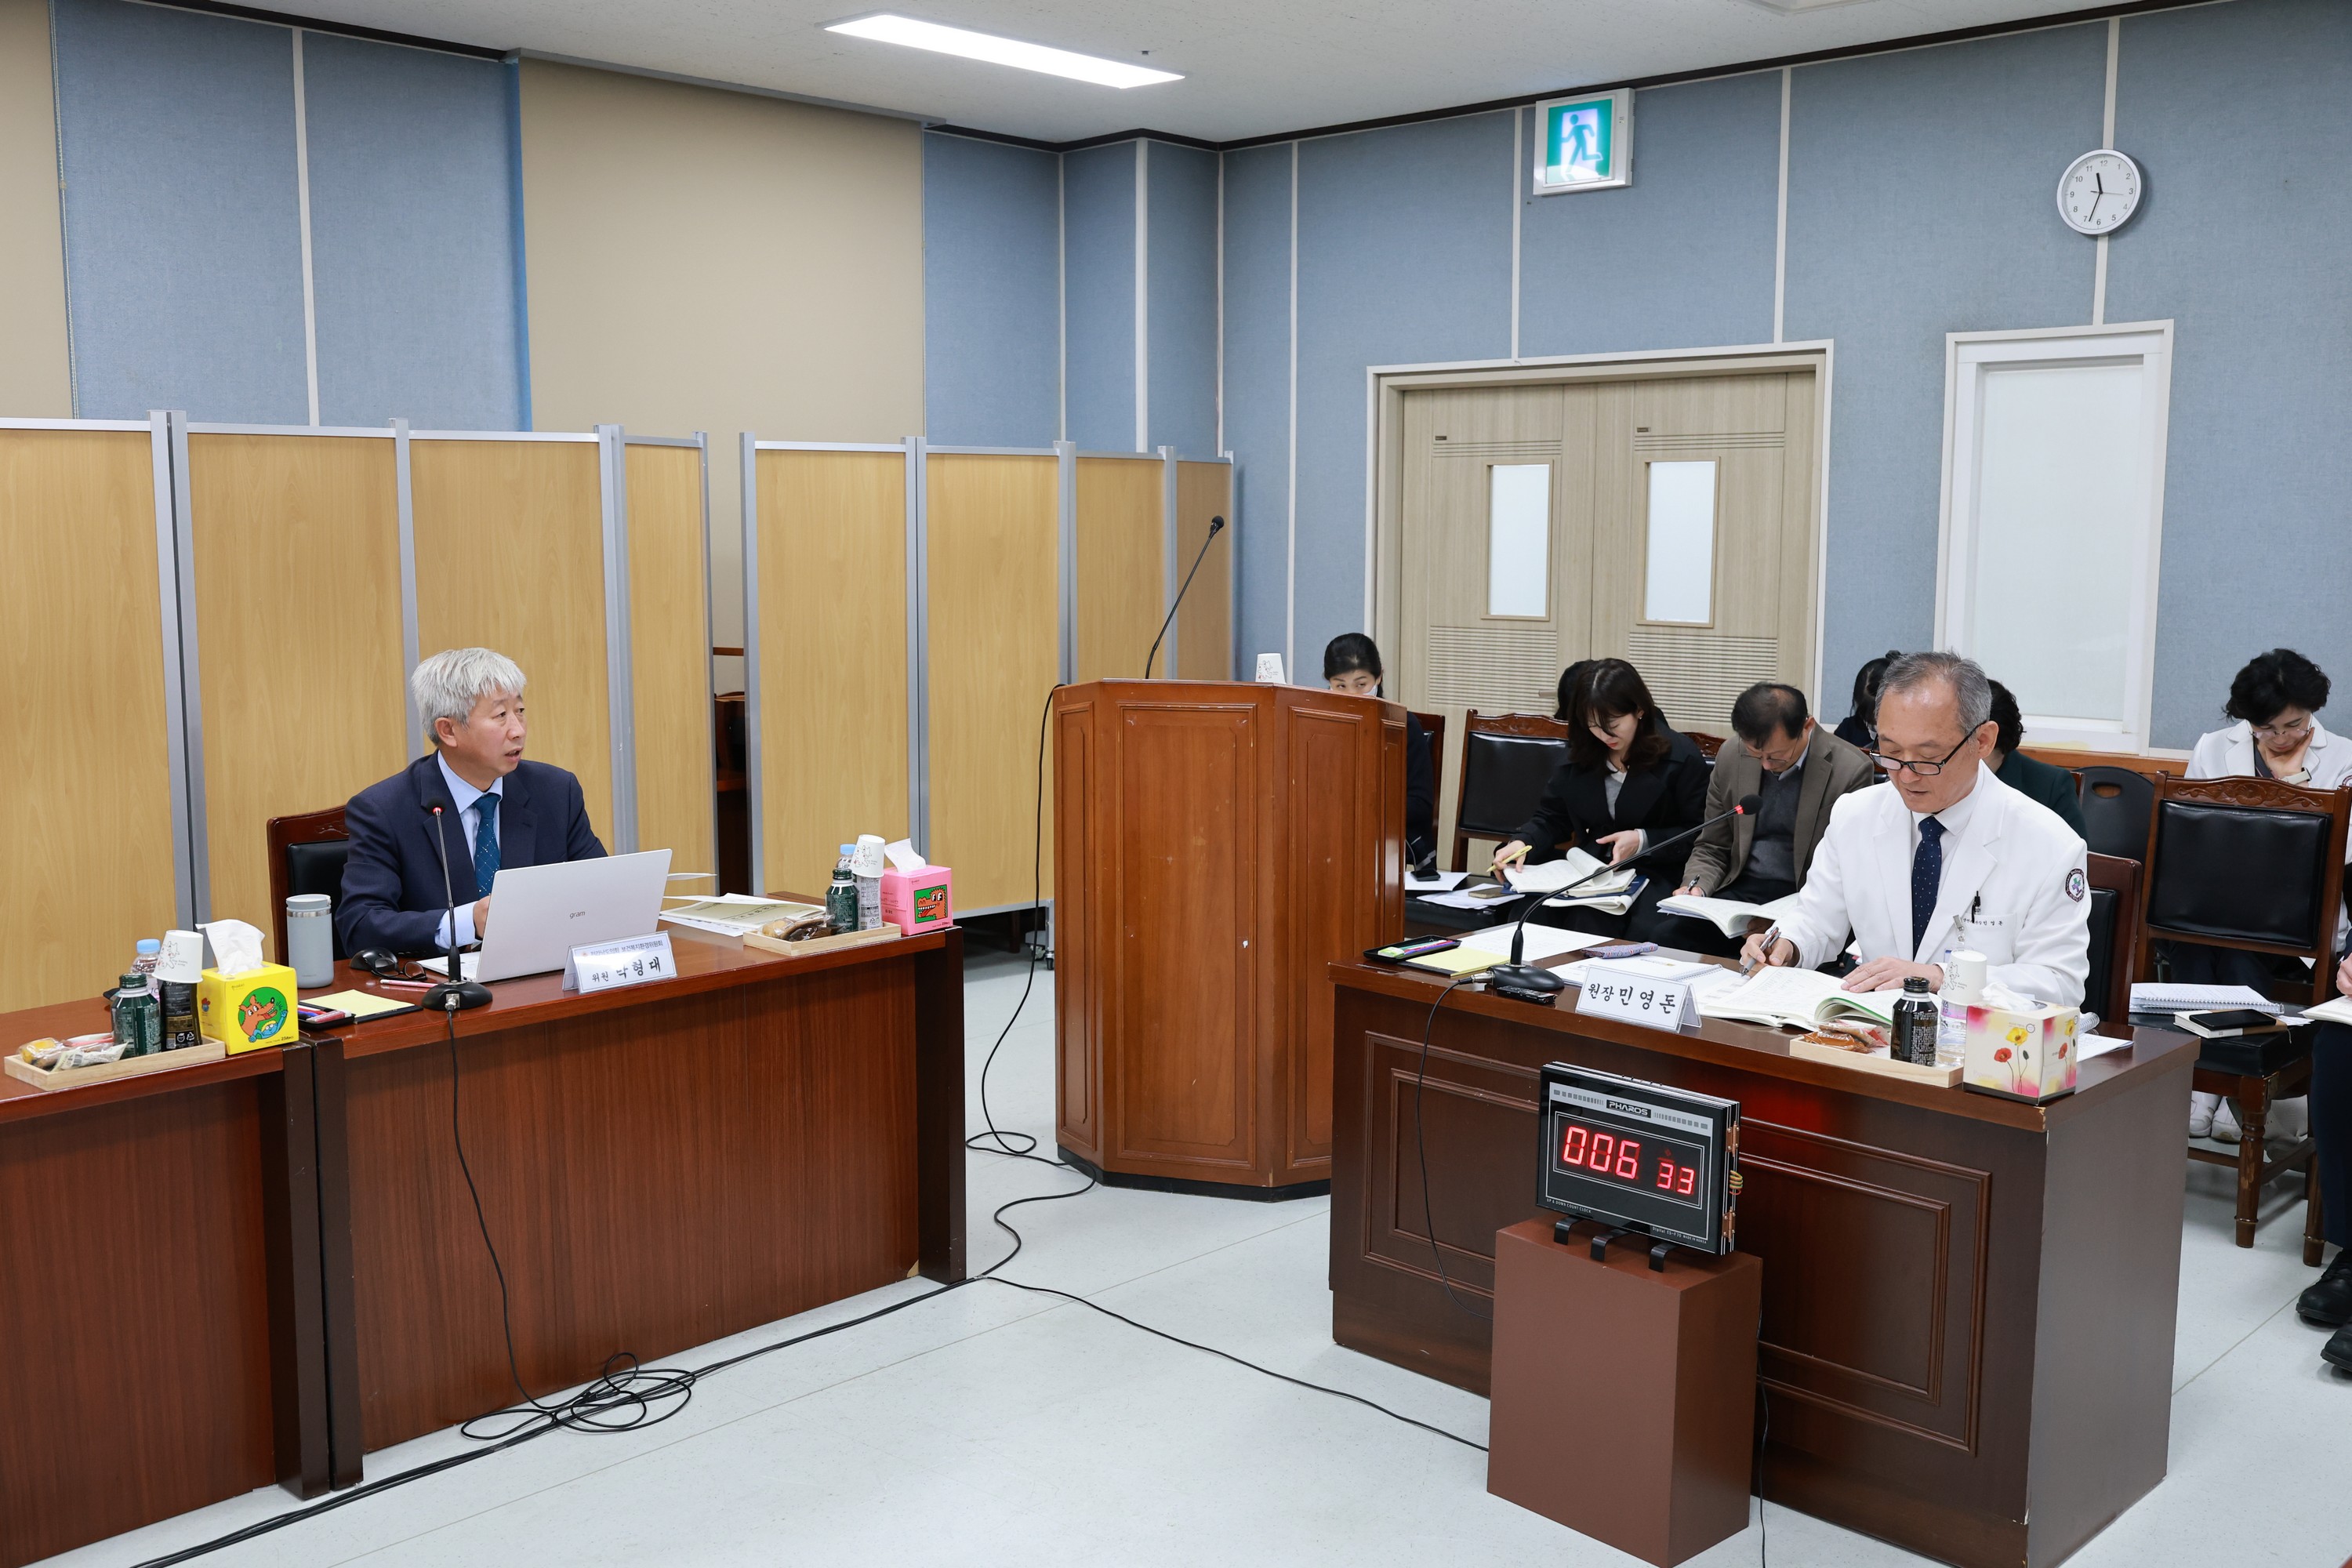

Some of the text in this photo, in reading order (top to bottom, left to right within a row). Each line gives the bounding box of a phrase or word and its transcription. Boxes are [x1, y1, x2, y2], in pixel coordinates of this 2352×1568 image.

[569, 910, 586, 919] gram
[592, 971, 608, 982] 위원
[1588, 983, 1675, 1014] 원장 민영돈
[1609, 1101, 1648, 1116] PHAROS
[1563, 1126, 1695, 1195] 006 33
